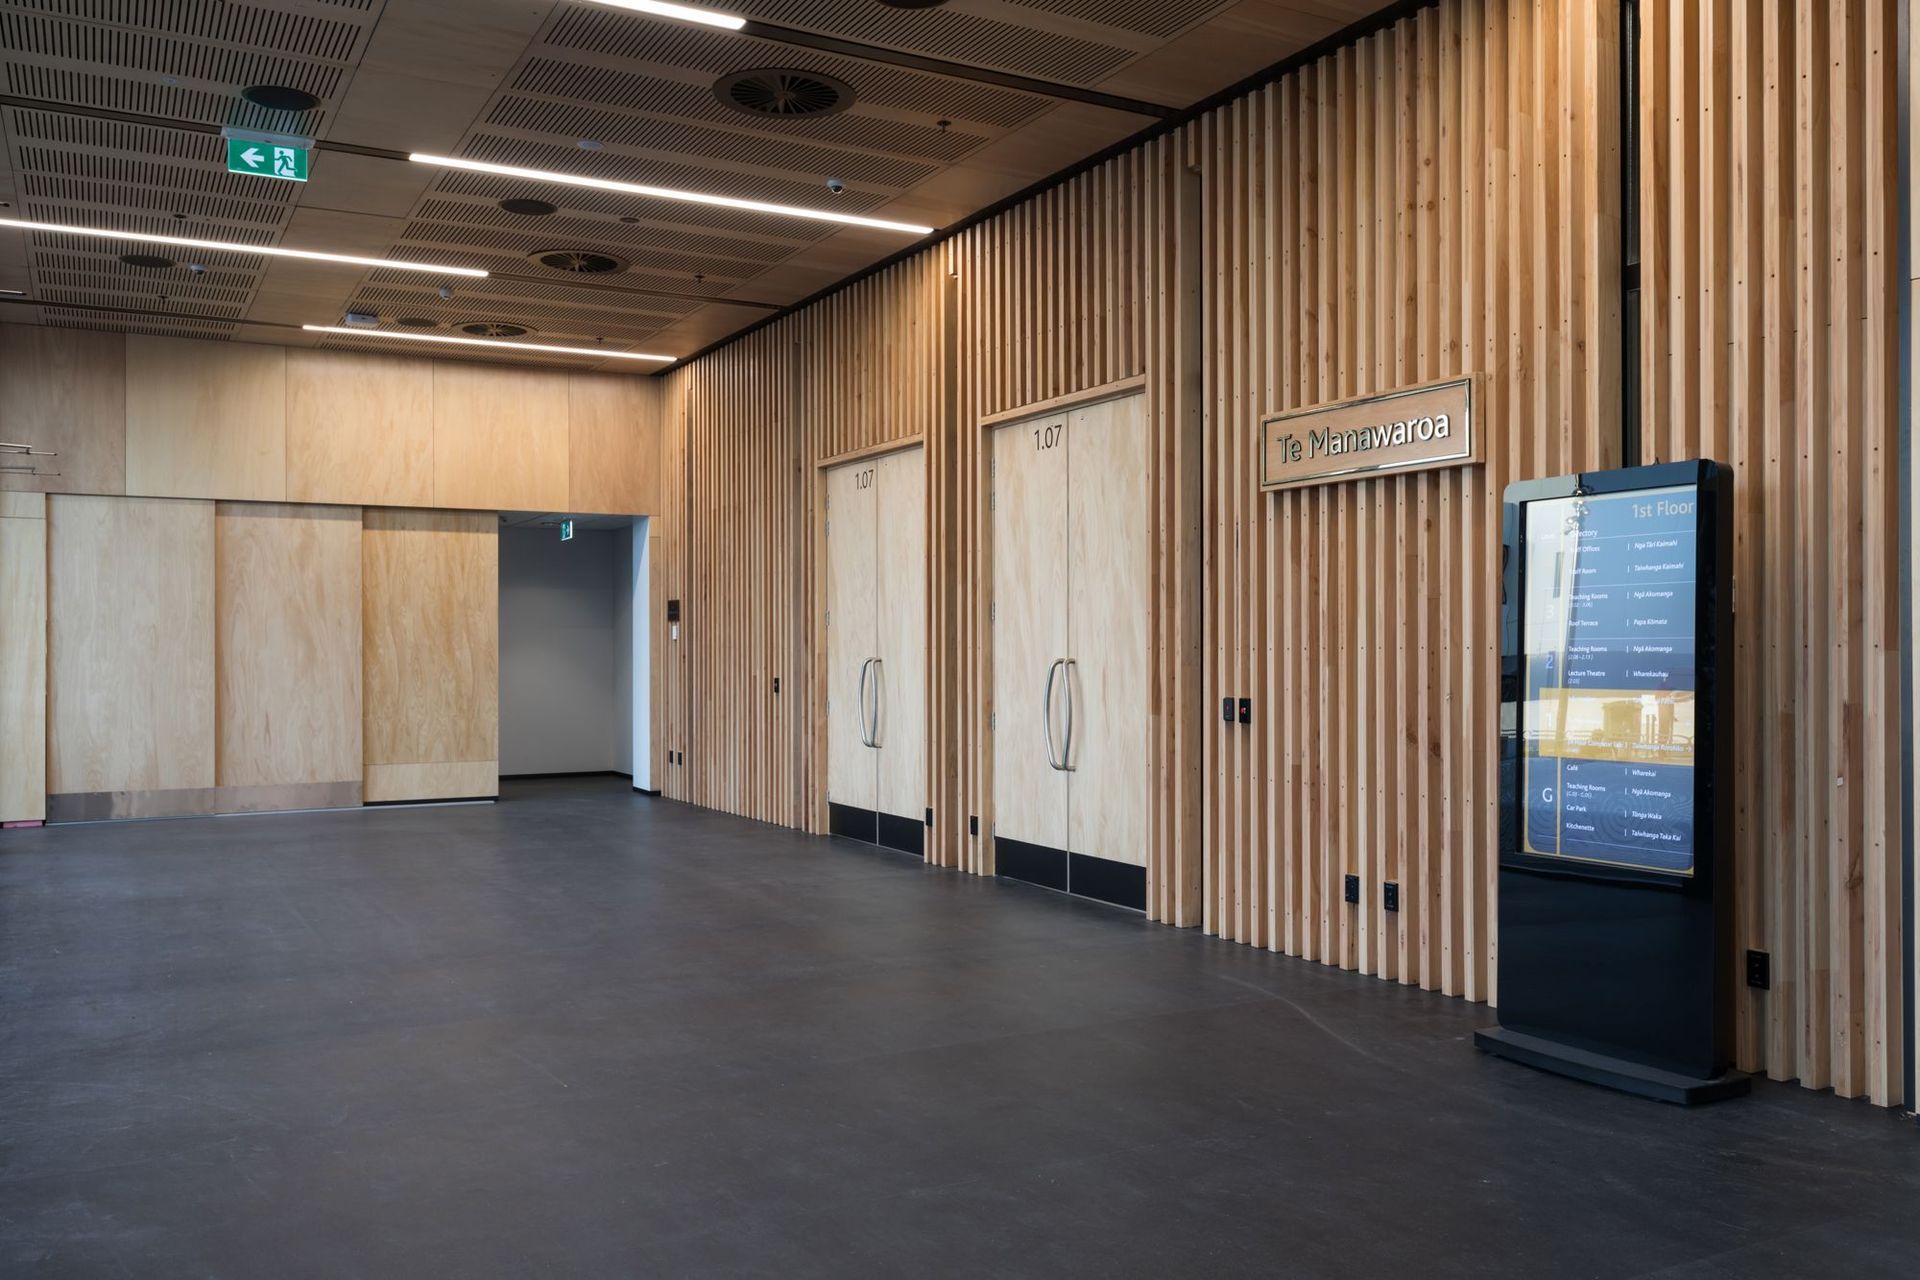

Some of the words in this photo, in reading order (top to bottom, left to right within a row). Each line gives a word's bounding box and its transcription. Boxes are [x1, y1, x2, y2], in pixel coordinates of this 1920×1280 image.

[1034, 424, 1062, 451] 1.07
[1278, 433, 1301, 463] Te
[1308, 413, 1450, 458] Manawaroa
[855, 469, 874, 490] 1.07
[1632, 502, 1652, 518] 1st
[1657, 500, 1694, 517] Floor
[1568, 646, 1589, 654] Teaching
[1545, 654, 1553, 669] 2
[1566, 782, 1588, 791] Teaching
[1589, 784, 1606, 792] Rooms
[1644, 789, 1671, 799] Akomanga
[1542, 787, 1553, 803] G
[1566, 822, 1595, 832] Kitchenette
[1632, 830, 1659, 840] Taiwhanga
